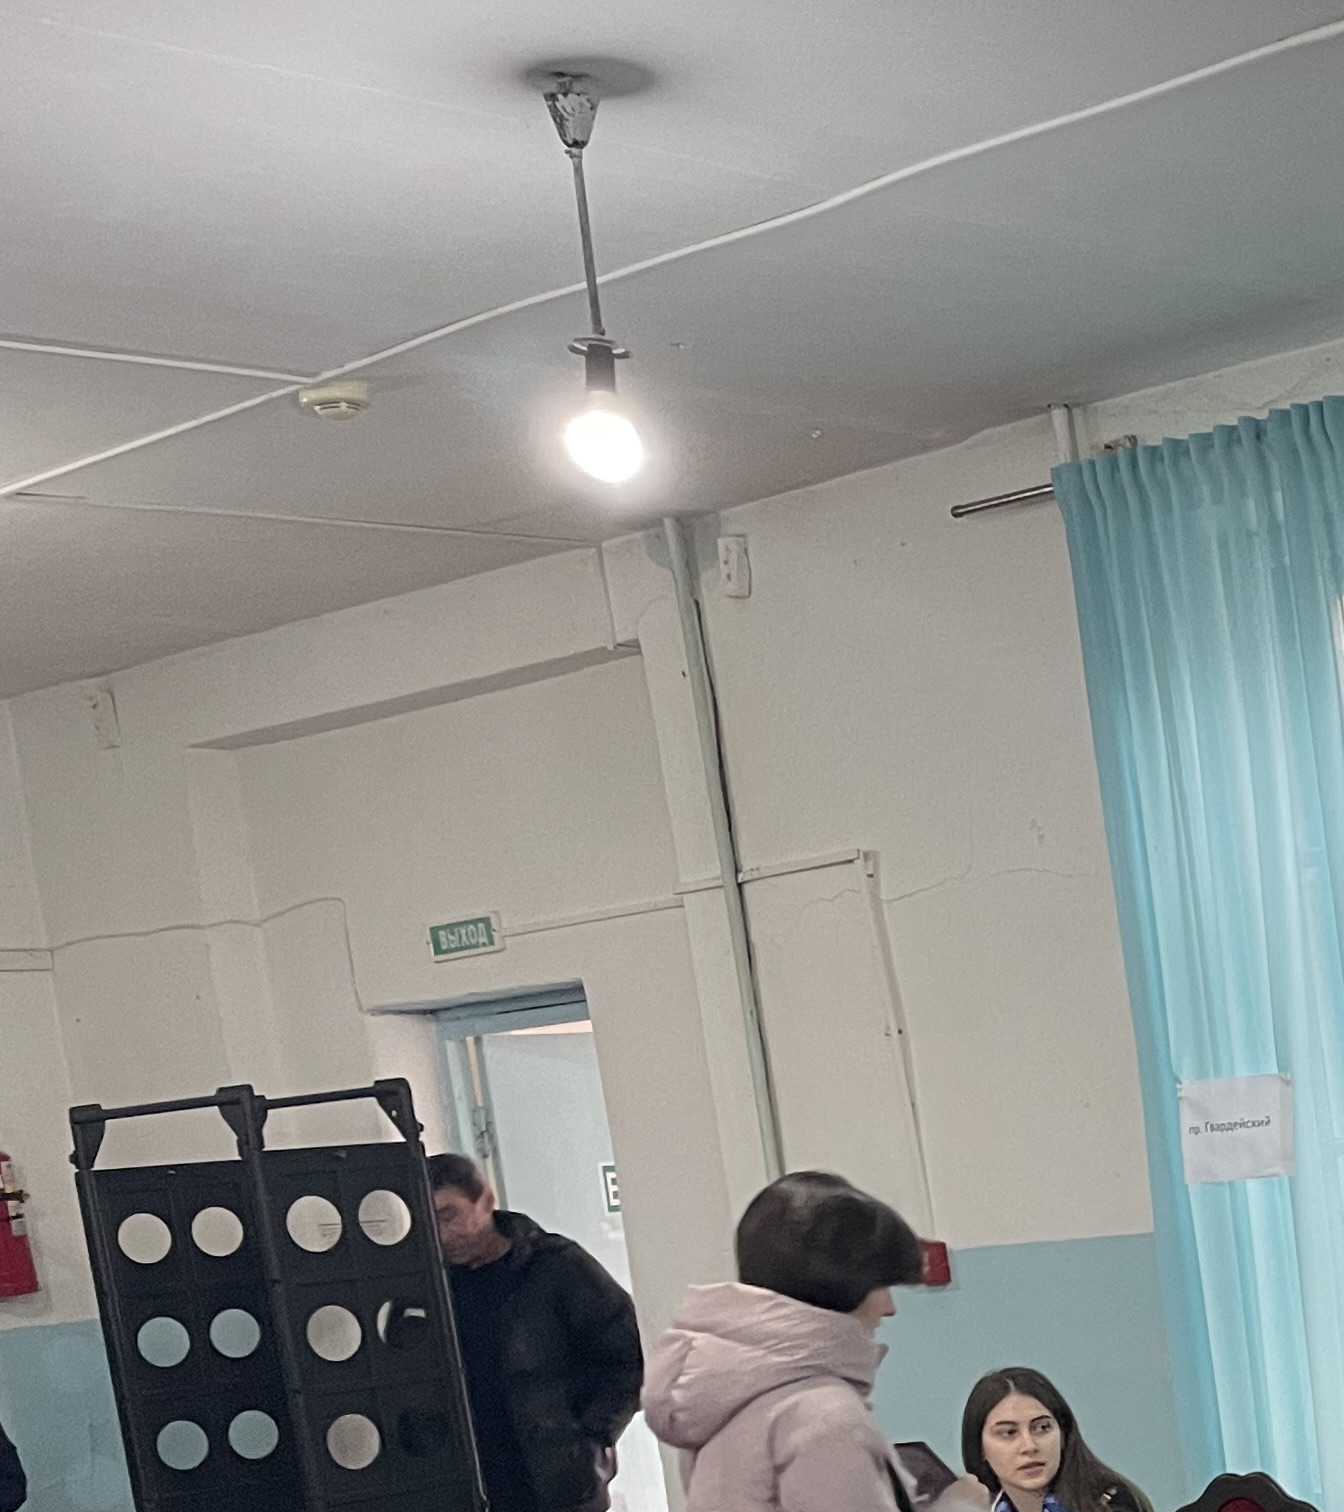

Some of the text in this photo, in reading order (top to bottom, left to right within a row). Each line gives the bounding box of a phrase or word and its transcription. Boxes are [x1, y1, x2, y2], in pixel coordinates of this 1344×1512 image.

[438, 923, 489, 950] ВЫХОД
[1188, 1115, 1271, 1136] пр. Гвардейский
